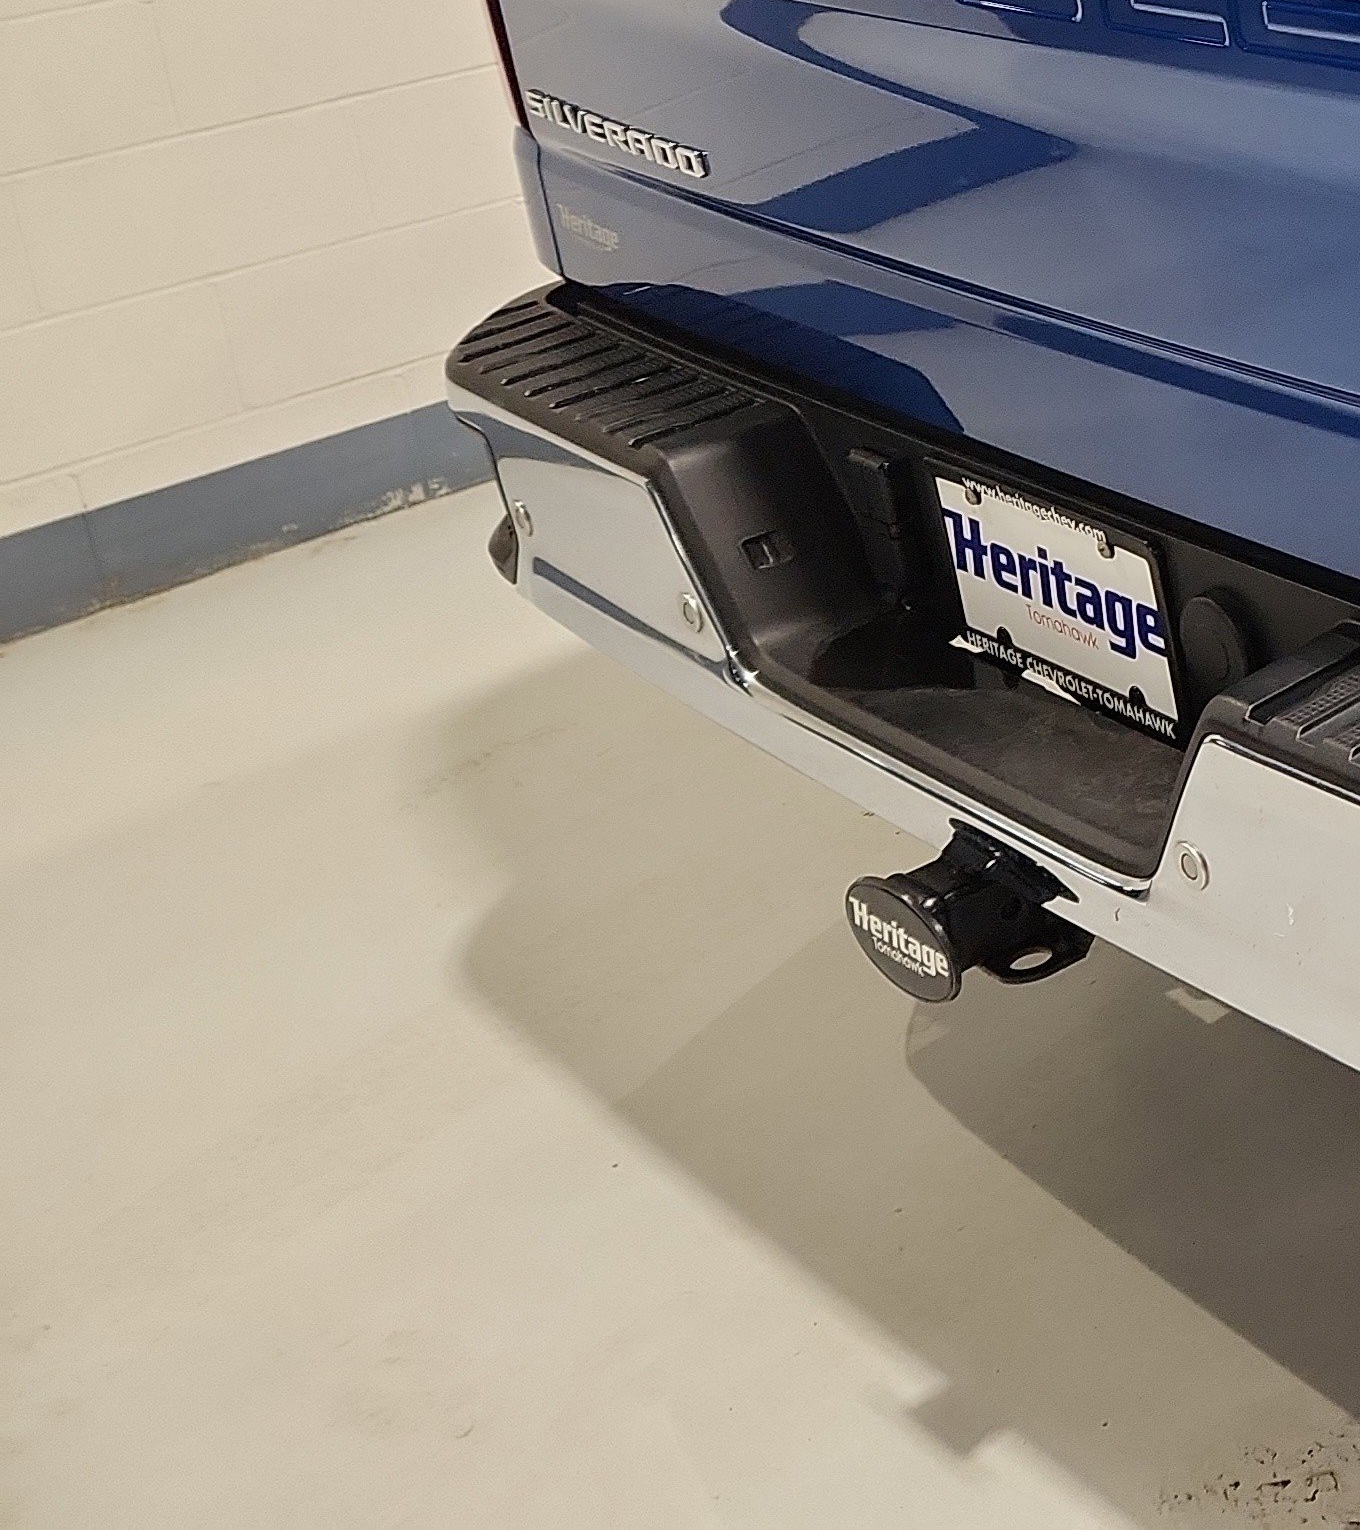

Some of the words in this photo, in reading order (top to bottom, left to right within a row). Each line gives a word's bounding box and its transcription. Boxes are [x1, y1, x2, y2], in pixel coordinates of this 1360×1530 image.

[525, 88, 711, 178] SILVERADO
[961, 476, 1107, 543] www.heritagechev.com
[942, 506, 1168, 659] Heritage
[1025, 603, 1100, 650] Tomahawk
[966, 629, 1025, 669] HERITAGE
[1025, 656, 1177, 740] CHEVROLET-TOMAHAWK
[849, 896, 950, 978] Heritage
